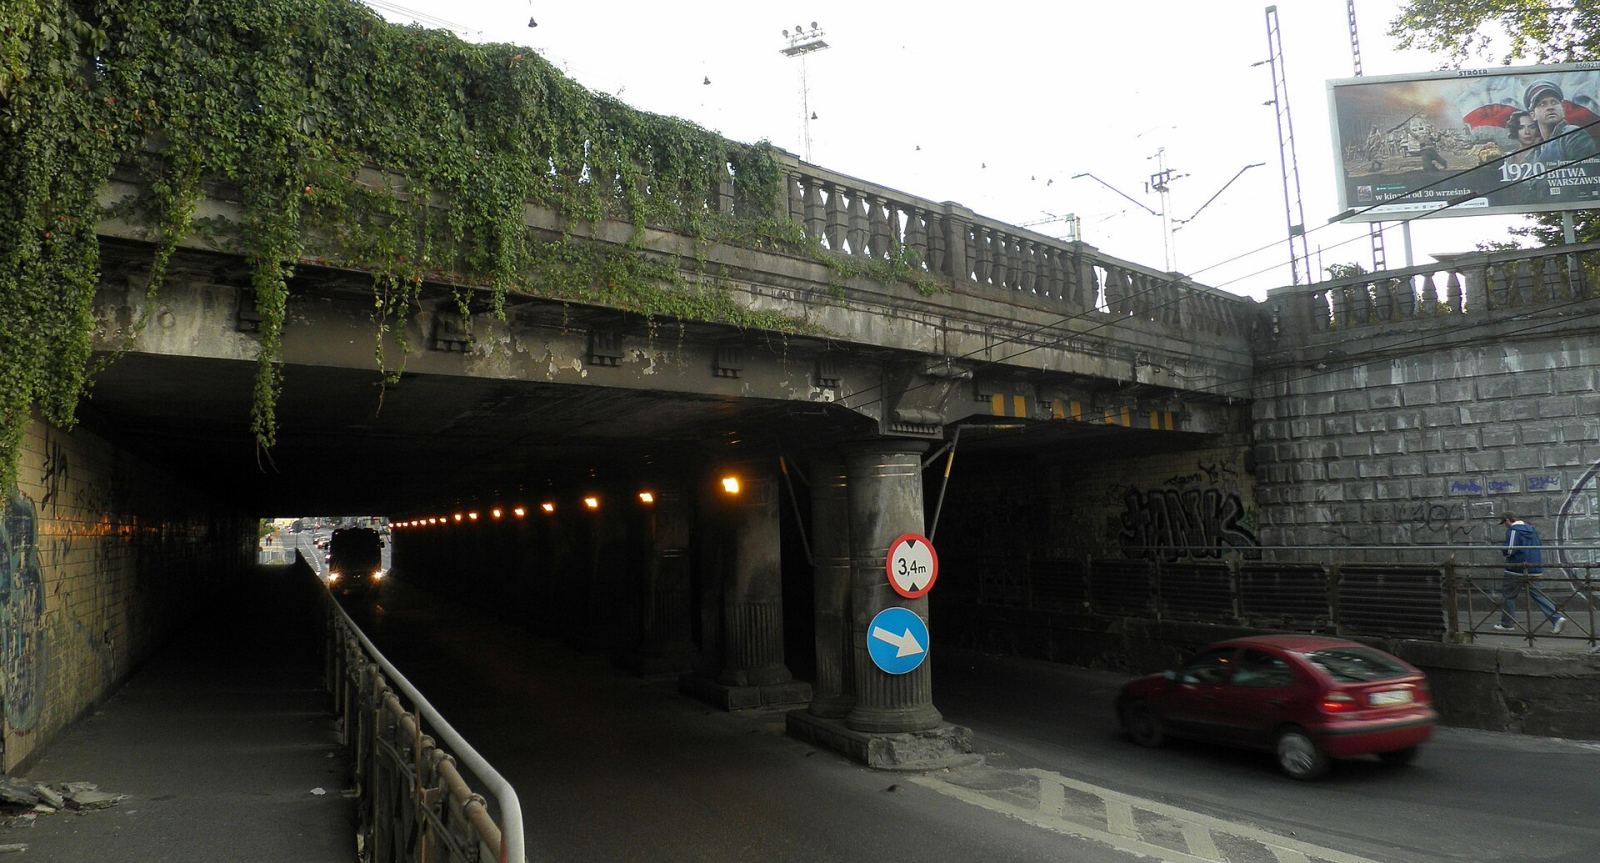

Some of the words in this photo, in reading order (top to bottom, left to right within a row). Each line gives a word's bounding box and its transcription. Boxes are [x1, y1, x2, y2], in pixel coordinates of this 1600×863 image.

[1498, 161, 1545, 182] 1920
[1547, 167, 1586, 179] BITWA
[1412, 190, 1422, 198] od
[1423, 190, 1434, 198] 30
[1435, 187, 1471, 197] września
